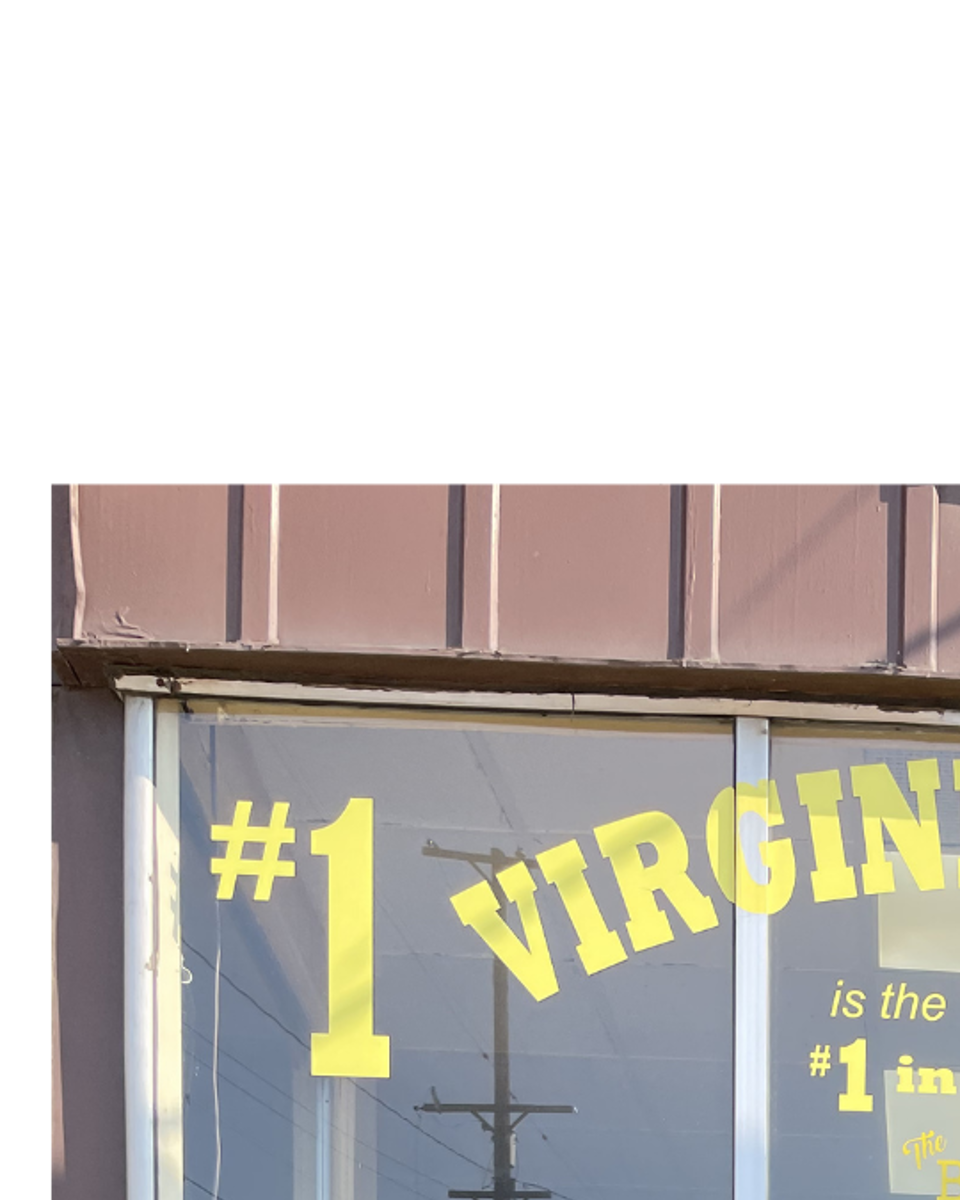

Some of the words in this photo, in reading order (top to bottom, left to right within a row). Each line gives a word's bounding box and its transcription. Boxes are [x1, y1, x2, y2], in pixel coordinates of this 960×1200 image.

[210, 797, 390, 1077] #1
[830, 979, 866, 1018] is
[880, 983, 946, 1021] the
[810, 1038, 873, 1112] #1
[896, 1055, 957, 1094] in
[902, 1130, 947, 1170] The
